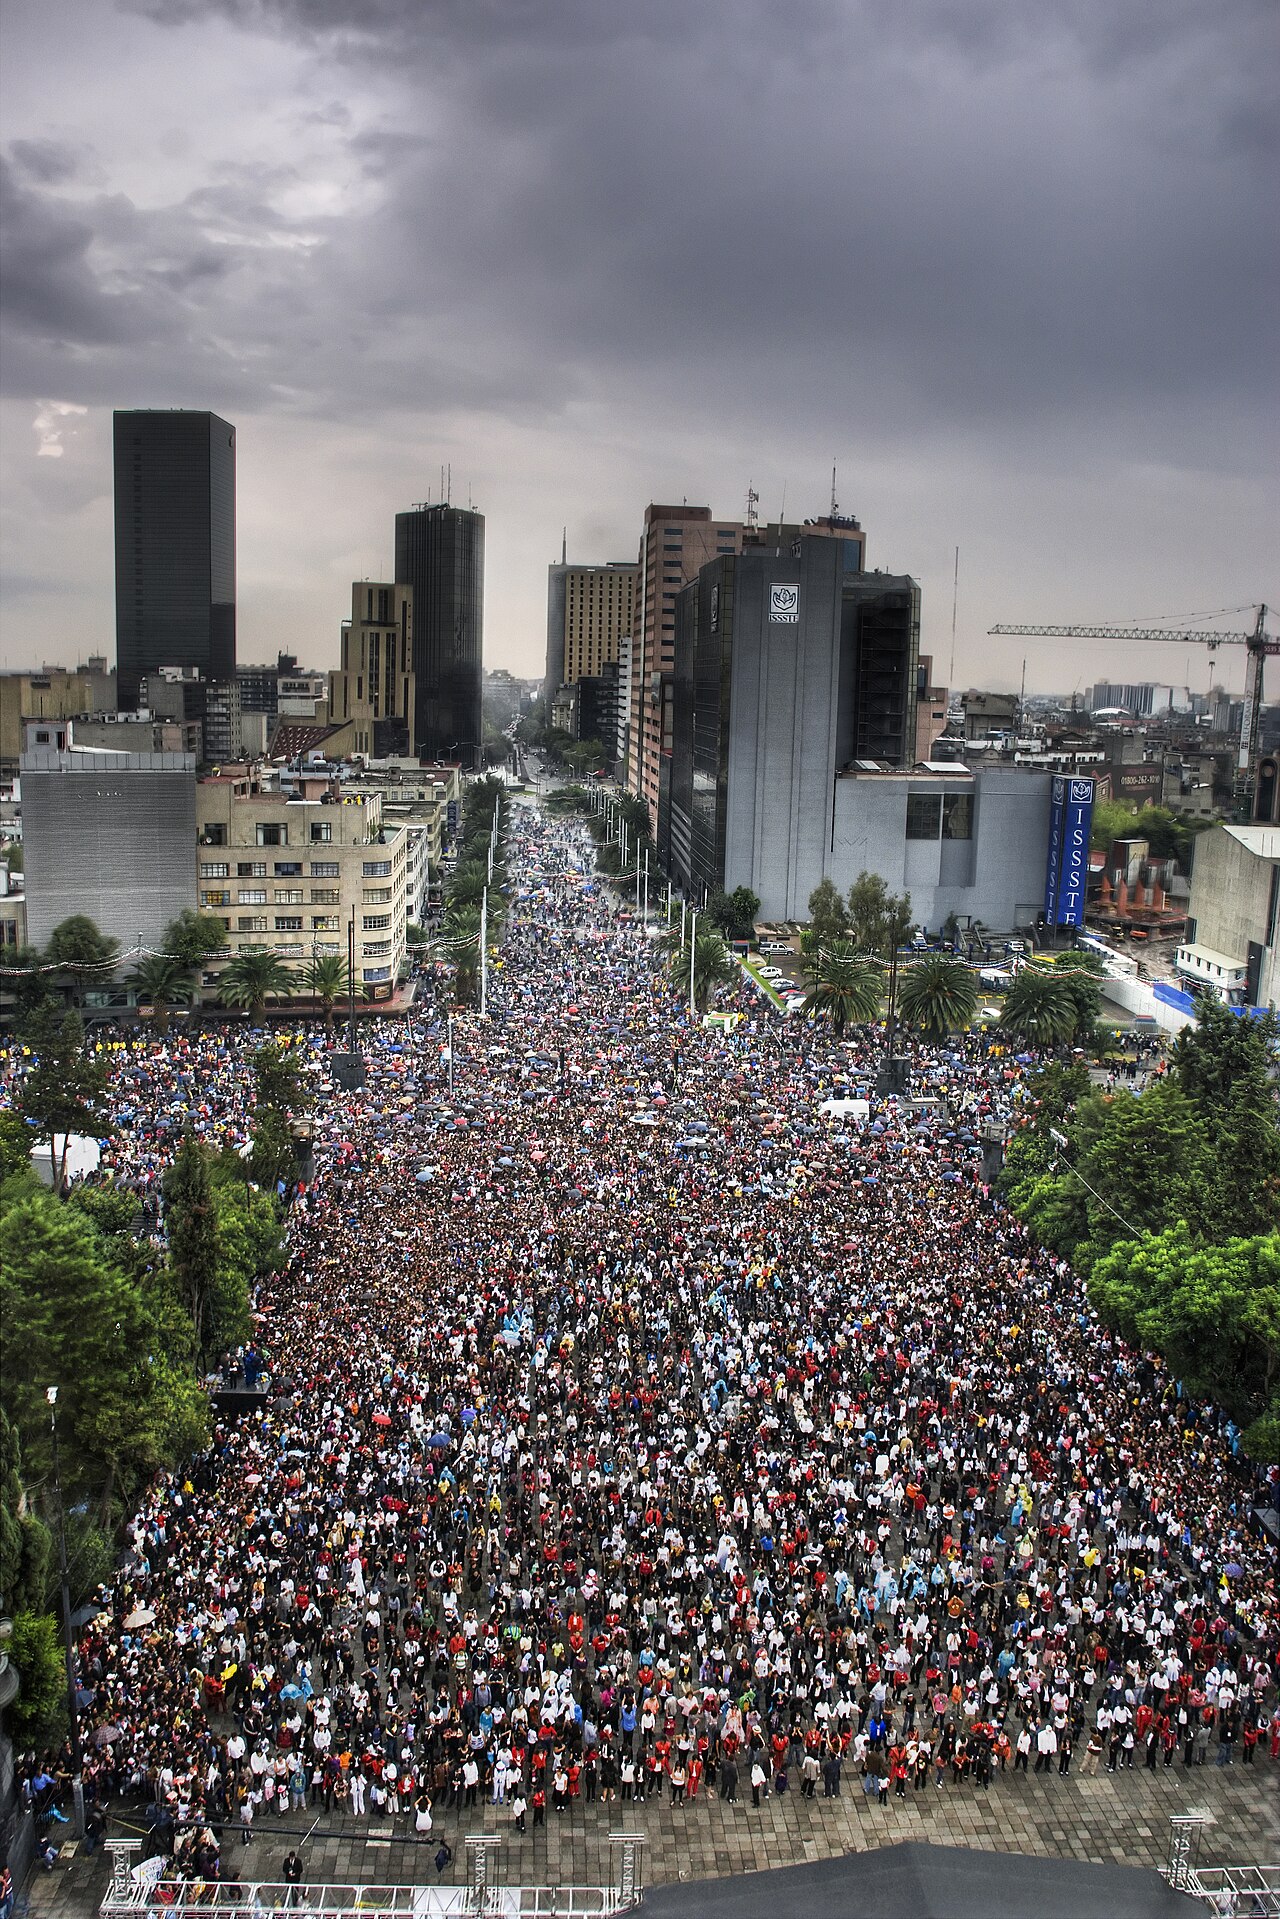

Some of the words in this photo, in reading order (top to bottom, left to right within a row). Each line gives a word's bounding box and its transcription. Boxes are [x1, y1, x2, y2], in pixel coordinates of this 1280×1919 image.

[1243, 700, 1253, 740] REFORMA
[1047, 809, 1059, 925] ISSSTE
[1065, 808, 1084, 925] ISSSTE
